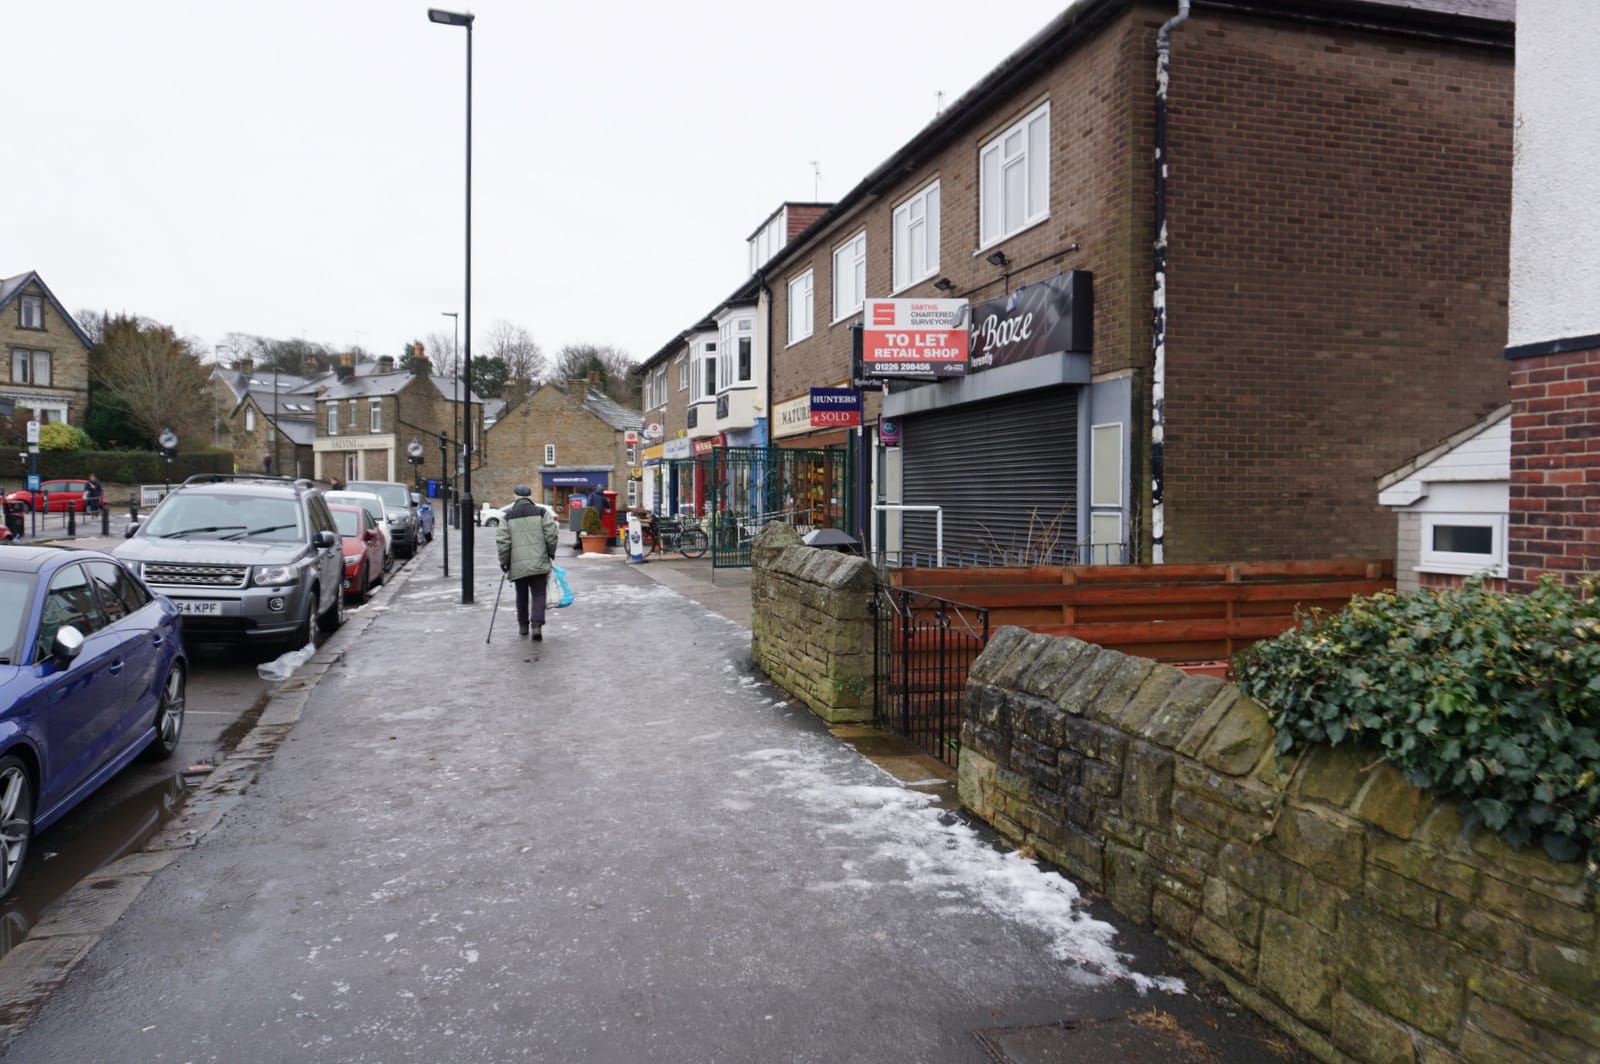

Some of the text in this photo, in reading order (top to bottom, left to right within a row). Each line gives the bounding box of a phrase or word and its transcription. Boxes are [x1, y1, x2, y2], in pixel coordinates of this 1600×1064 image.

[982, 312, 1033, 351] Booze
[885, 334, 949, 346] TO LET
[874, 348, 959, 358] RETAIL SHOP
[875, 363, 899, 371] 01226
[813, 396, 857, 404] HUNTERS
[821, 412, 850, 422] SOLD
[194, 603, 217, 612] KPF
